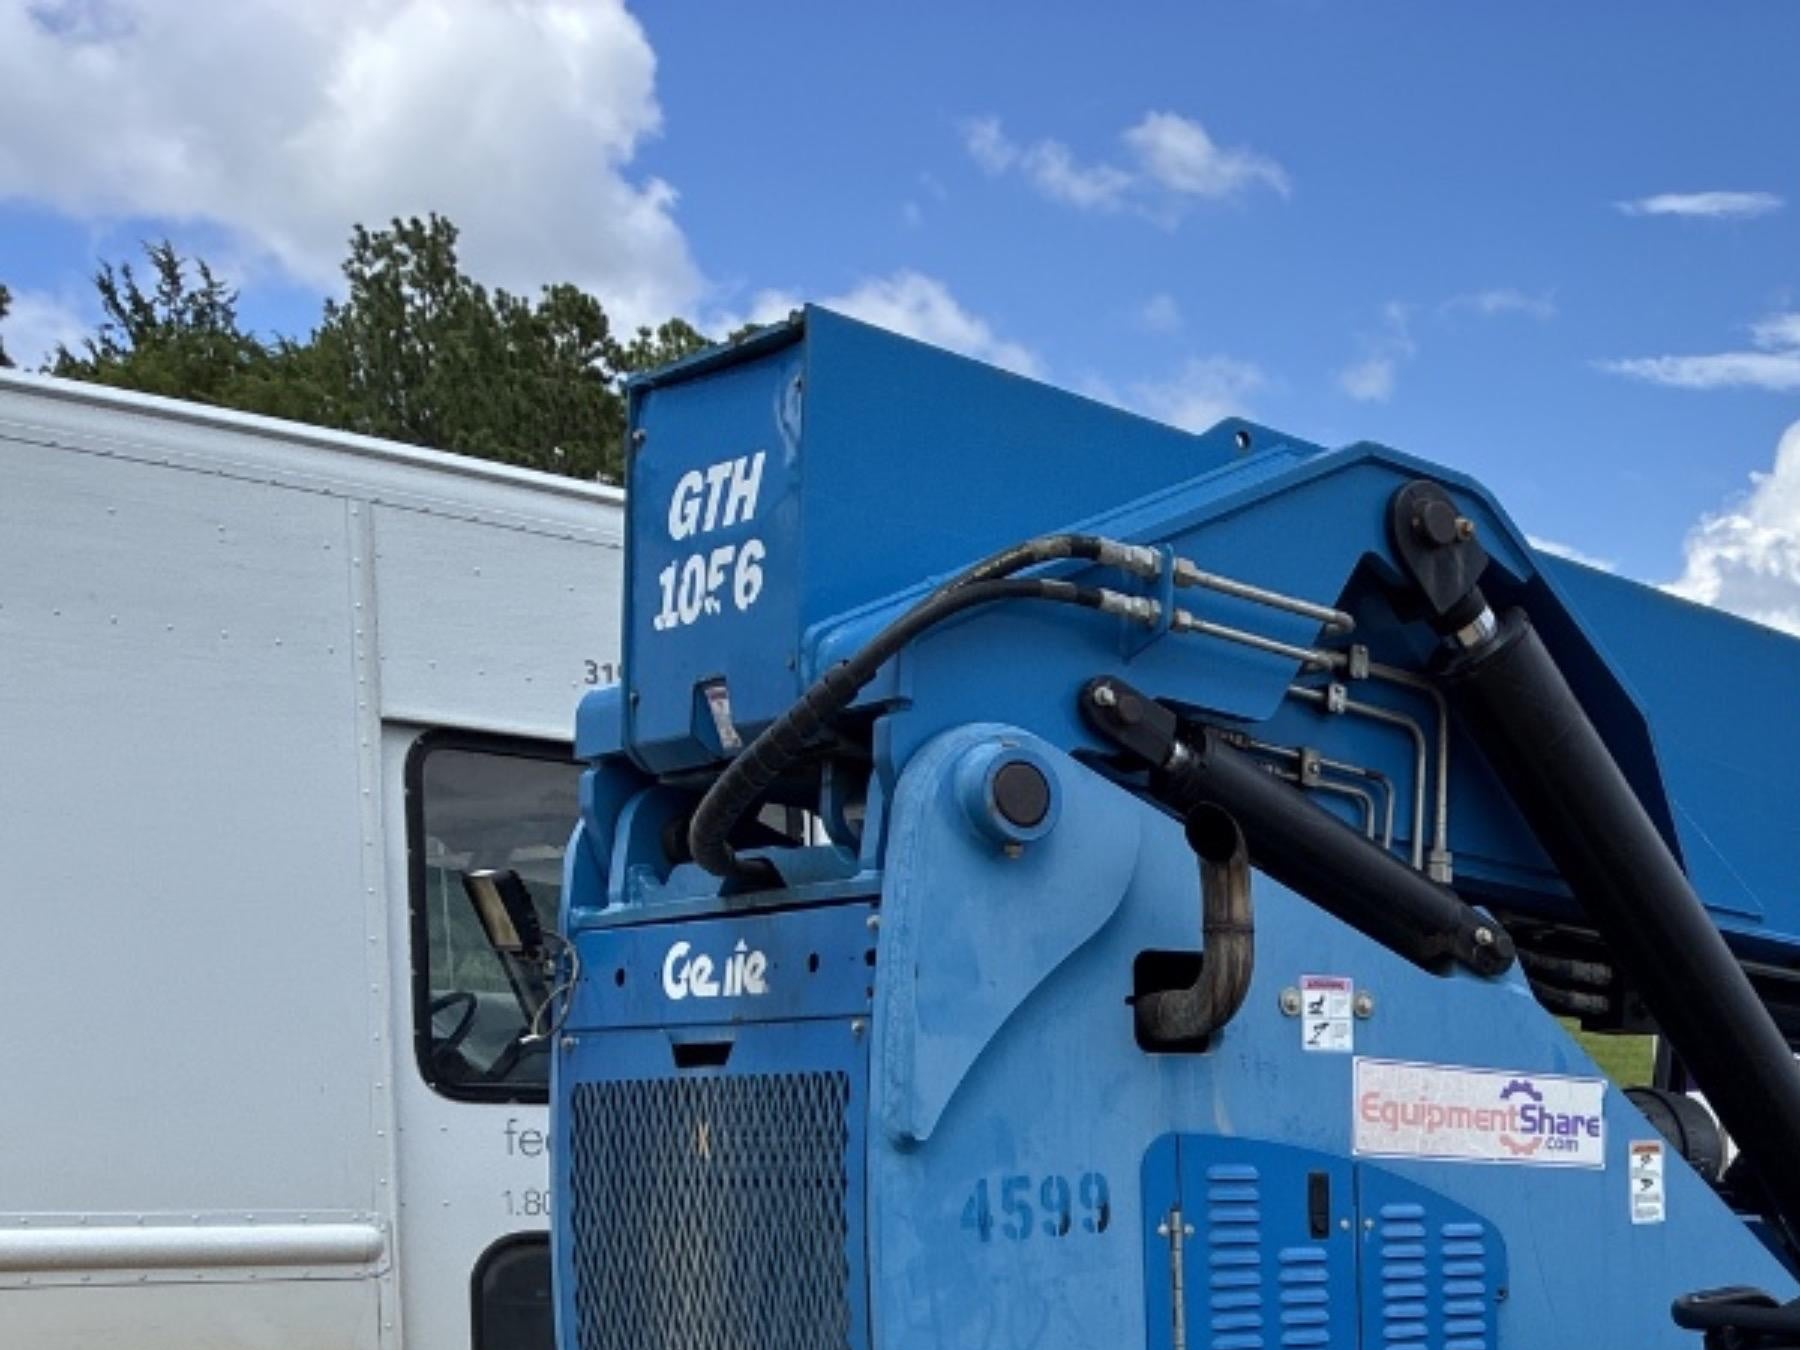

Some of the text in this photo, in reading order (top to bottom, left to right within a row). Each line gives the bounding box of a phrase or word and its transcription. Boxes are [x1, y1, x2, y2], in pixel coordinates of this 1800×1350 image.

[668, 449, 767, 541] GTH
[653, 538, 766, 631] 1056
[503, 1118, 551, 1157] fe
[1360, 1091, 1601, 1138] EquipmentShare
[960, 1171, 1111, 1242] 4599
